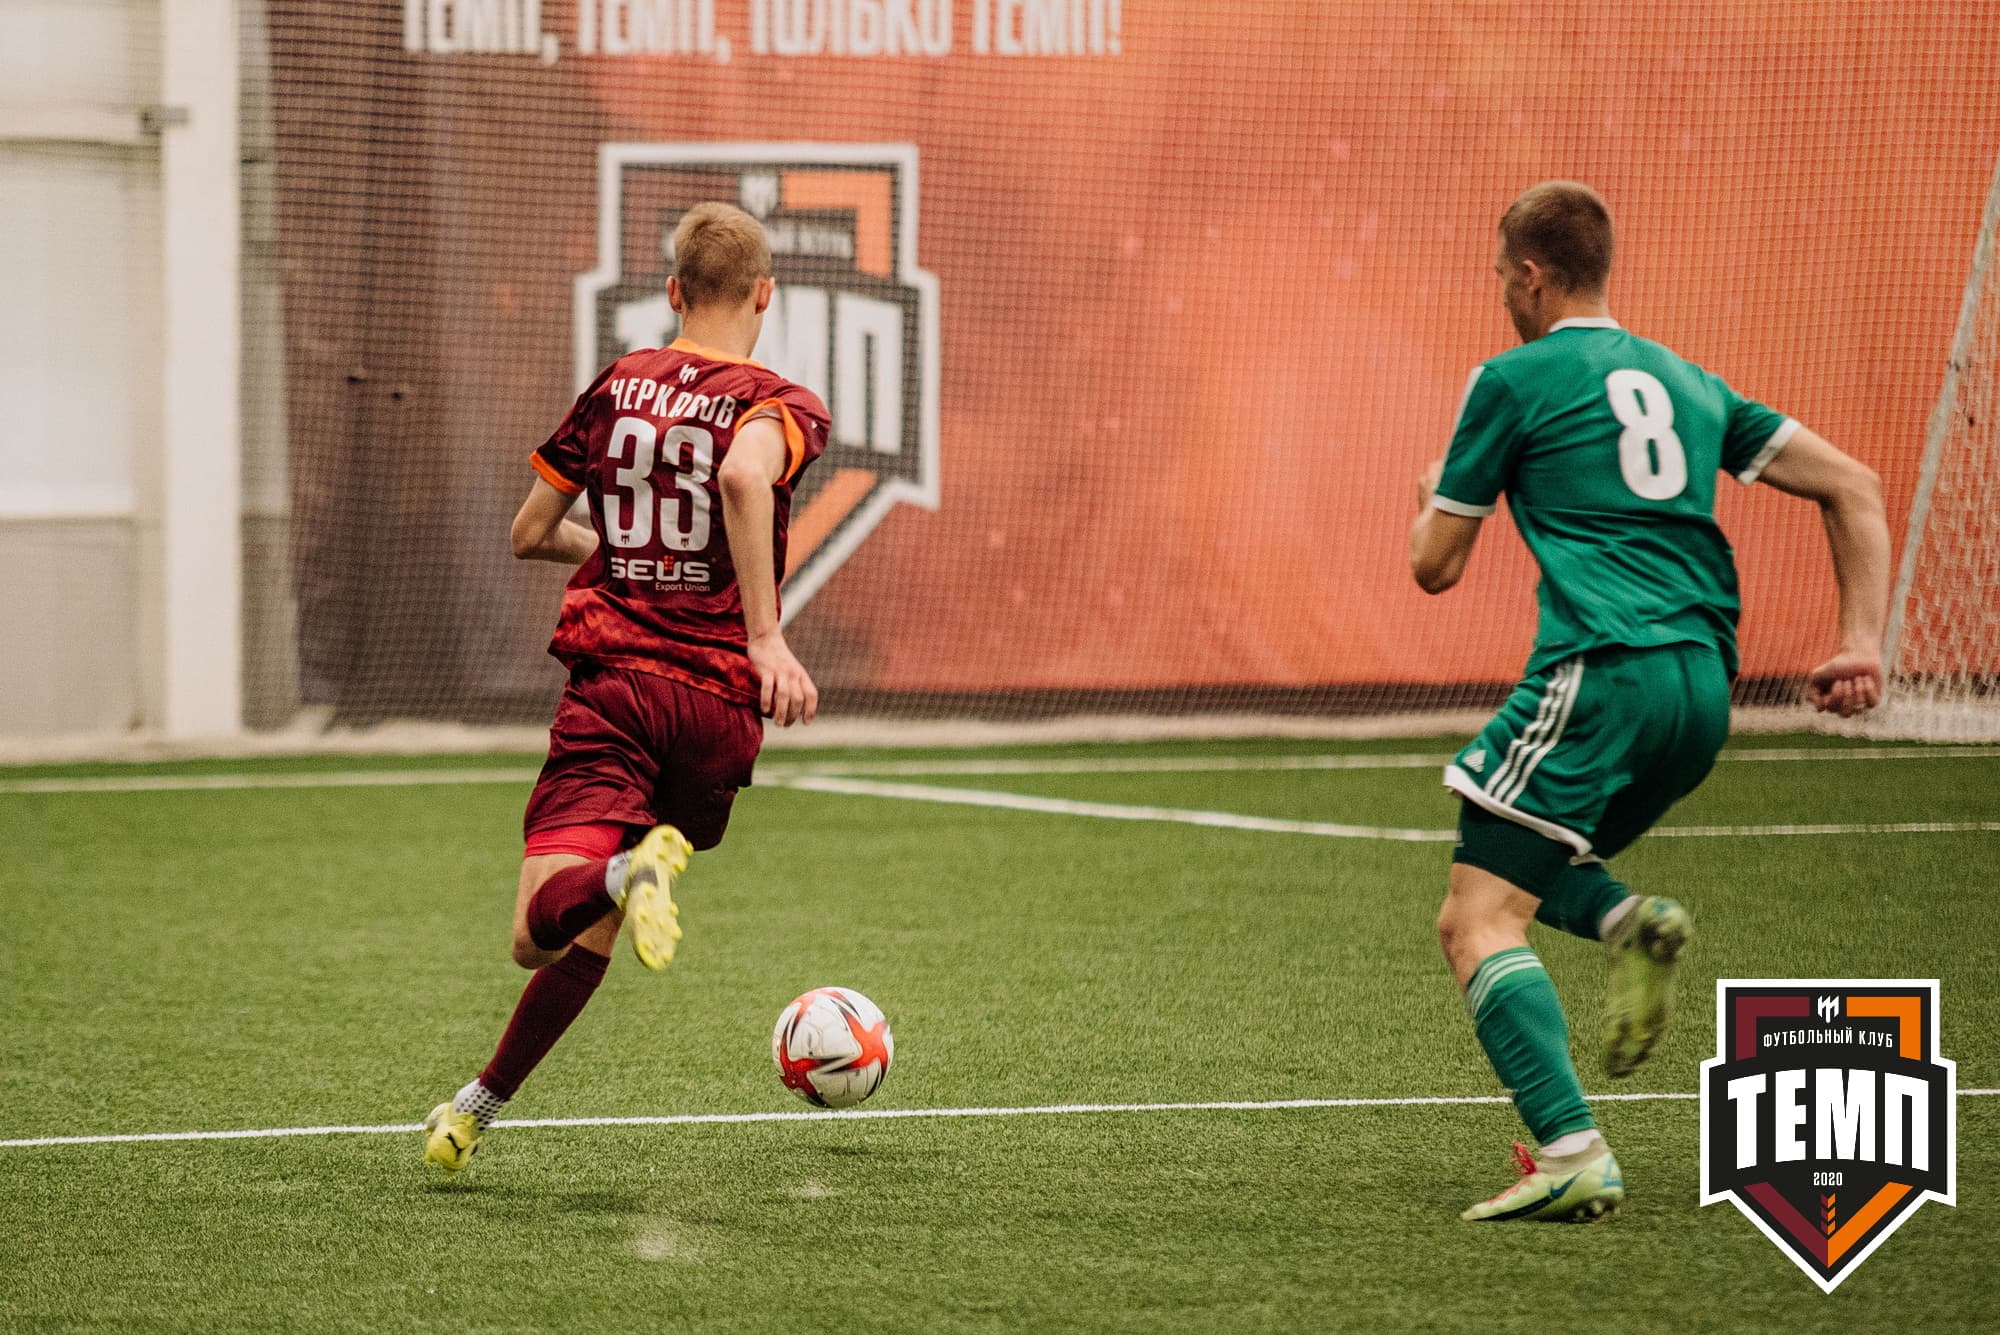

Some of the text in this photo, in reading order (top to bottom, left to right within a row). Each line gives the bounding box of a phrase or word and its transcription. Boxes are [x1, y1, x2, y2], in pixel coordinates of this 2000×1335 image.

[603, 416, 713, 551] 33
[1605, 368, 1688, 501] 8
[655, 582, 711, 592] Export Union
